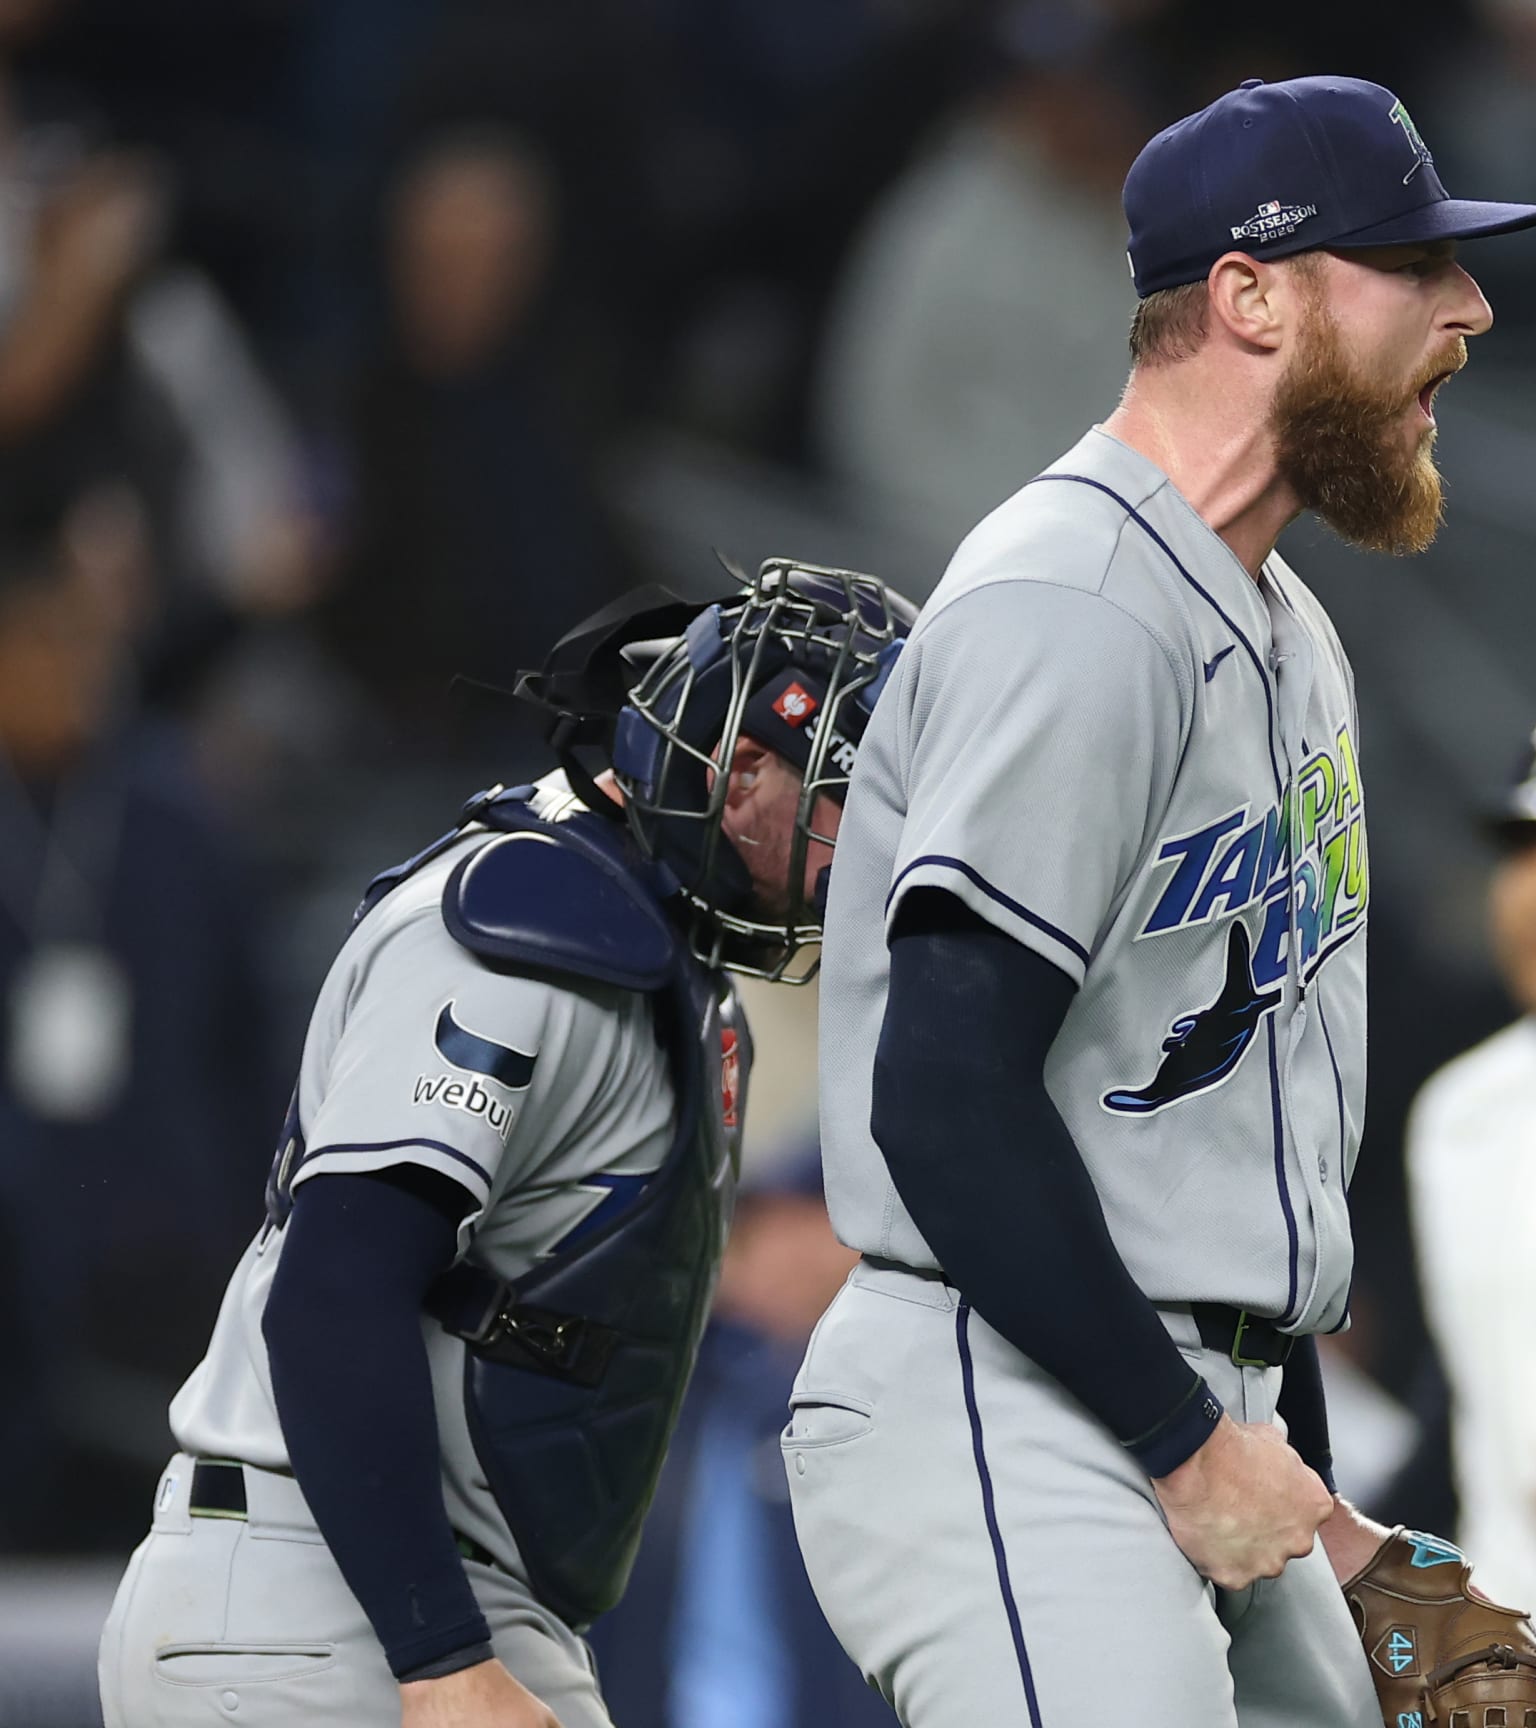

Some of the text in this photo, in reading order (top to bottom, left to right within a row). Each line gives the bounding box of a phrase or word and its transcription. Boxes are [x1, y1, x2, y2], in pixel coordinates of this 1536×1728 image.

[1230, 204, 1318, 240] POSTSEASON
[1133, 719, 1367, 942] TAMPA
[1251, 814, 1369, 994] BAY
[412, 1073, 514, 1142] Webul
